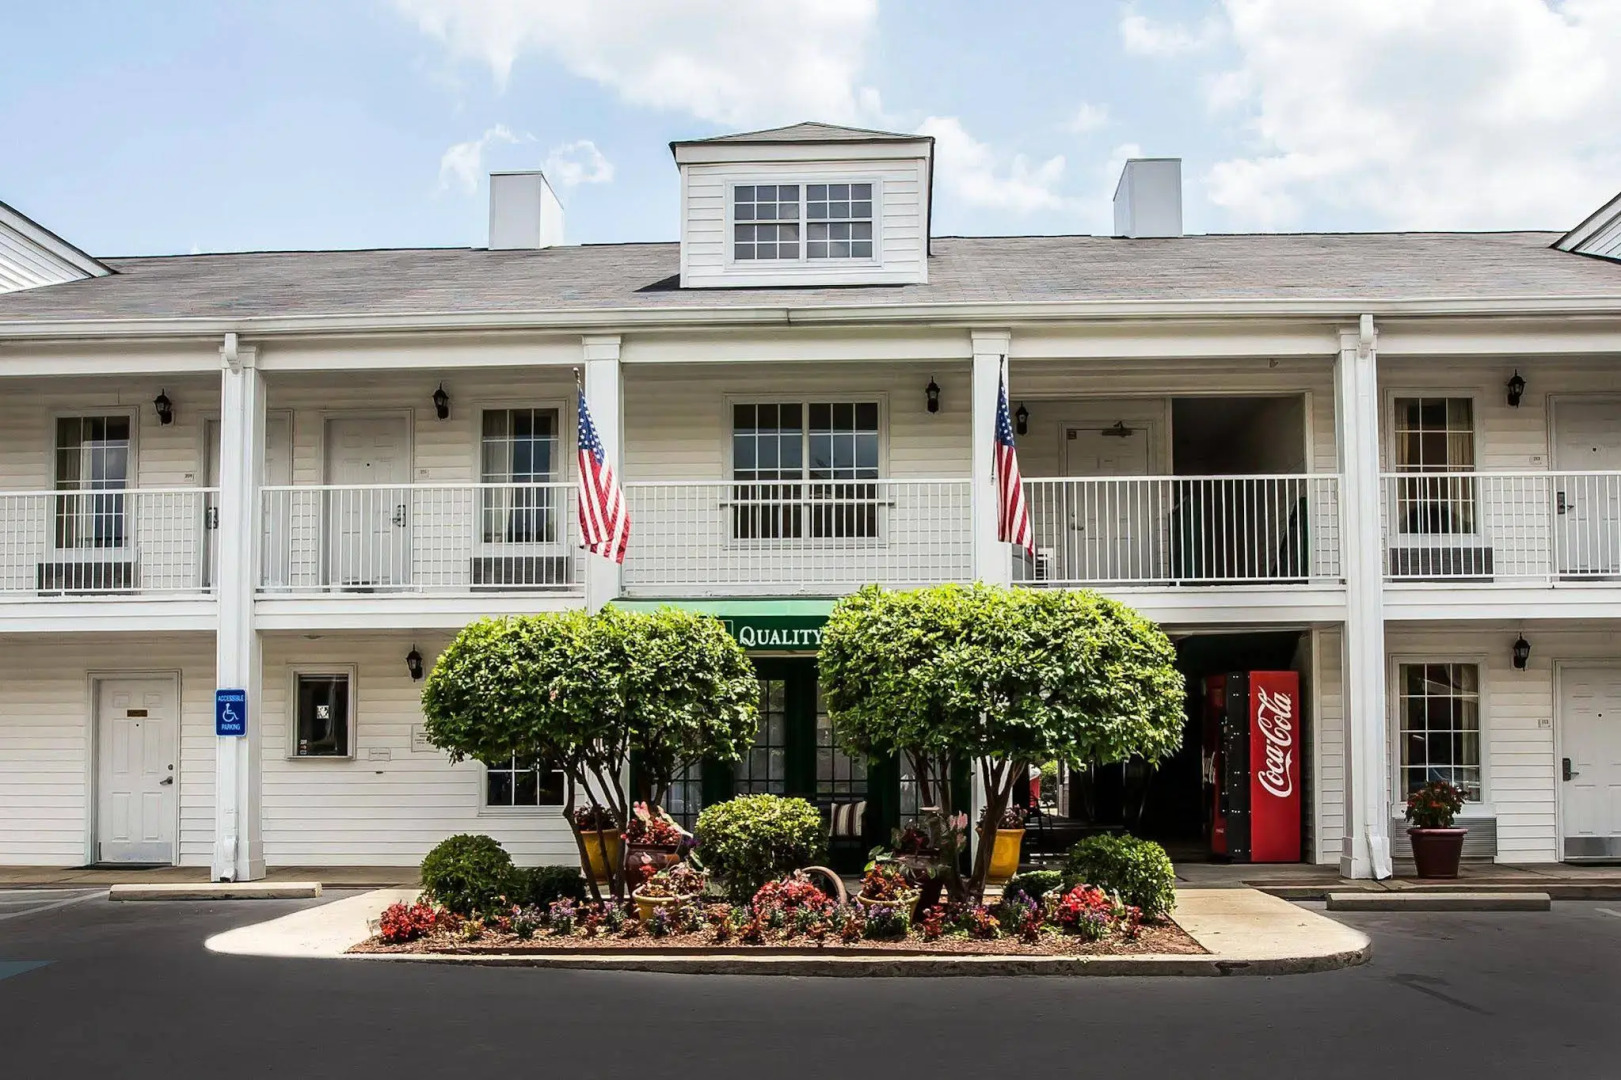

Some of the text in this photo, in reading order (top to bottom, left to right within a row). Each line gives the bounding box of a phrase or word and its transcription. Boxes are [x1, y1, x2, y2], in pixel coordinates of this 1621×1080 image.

[740, 626, 823, 647] QUALITY
[218, 694, 244, 702] ACCESSIBLE
[221, 723, 241, 731] PARKING
